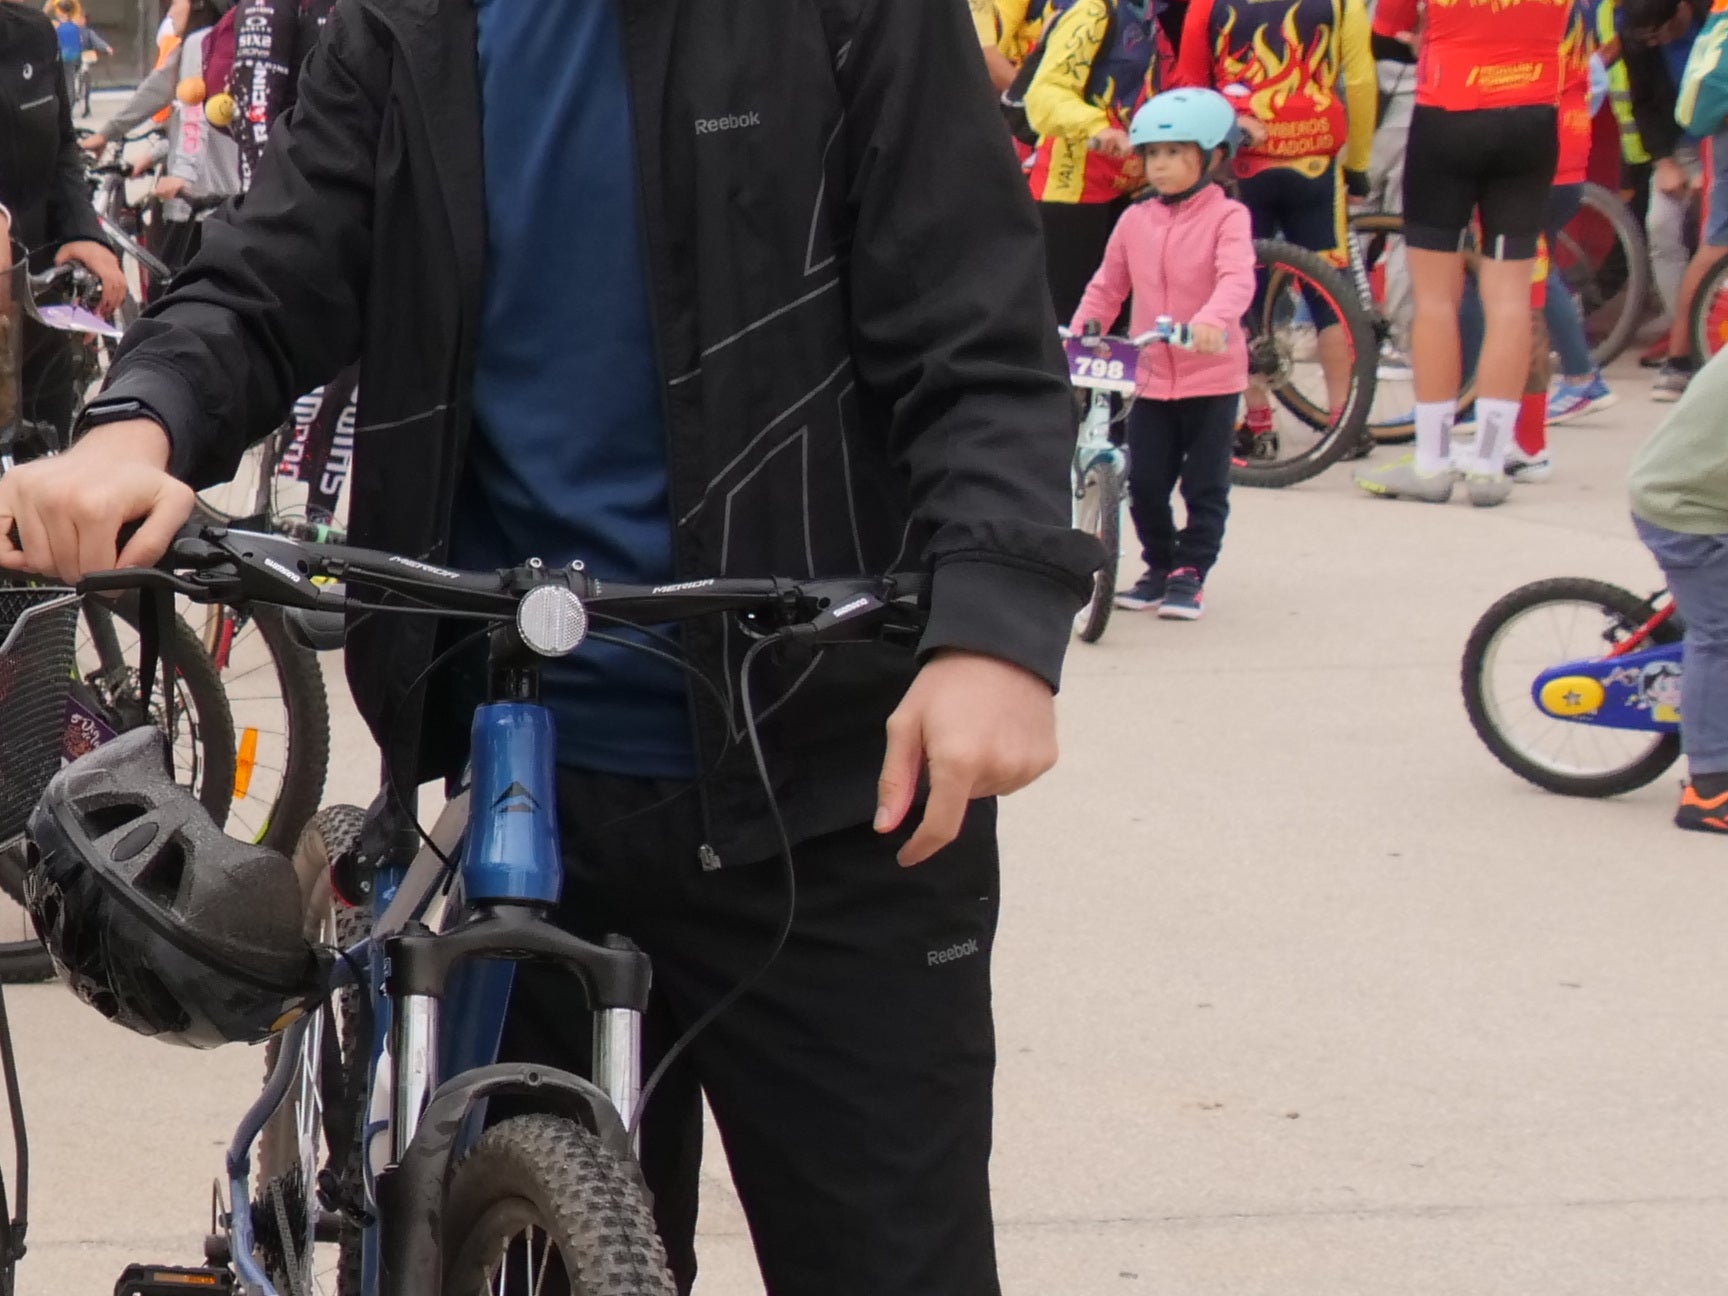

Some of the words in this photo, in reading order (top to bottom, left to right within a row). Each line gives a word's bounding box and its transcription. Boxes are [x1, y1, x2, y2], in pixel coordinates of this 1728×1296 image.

[694, 111, 761, 136] Reebok
[1074, 355, 1125, 380] 798
[388, 555, 461, 580] MERIDA
[651, 578, 716, 595] MERIDA
[926, 936, 980, 968] Reebok
